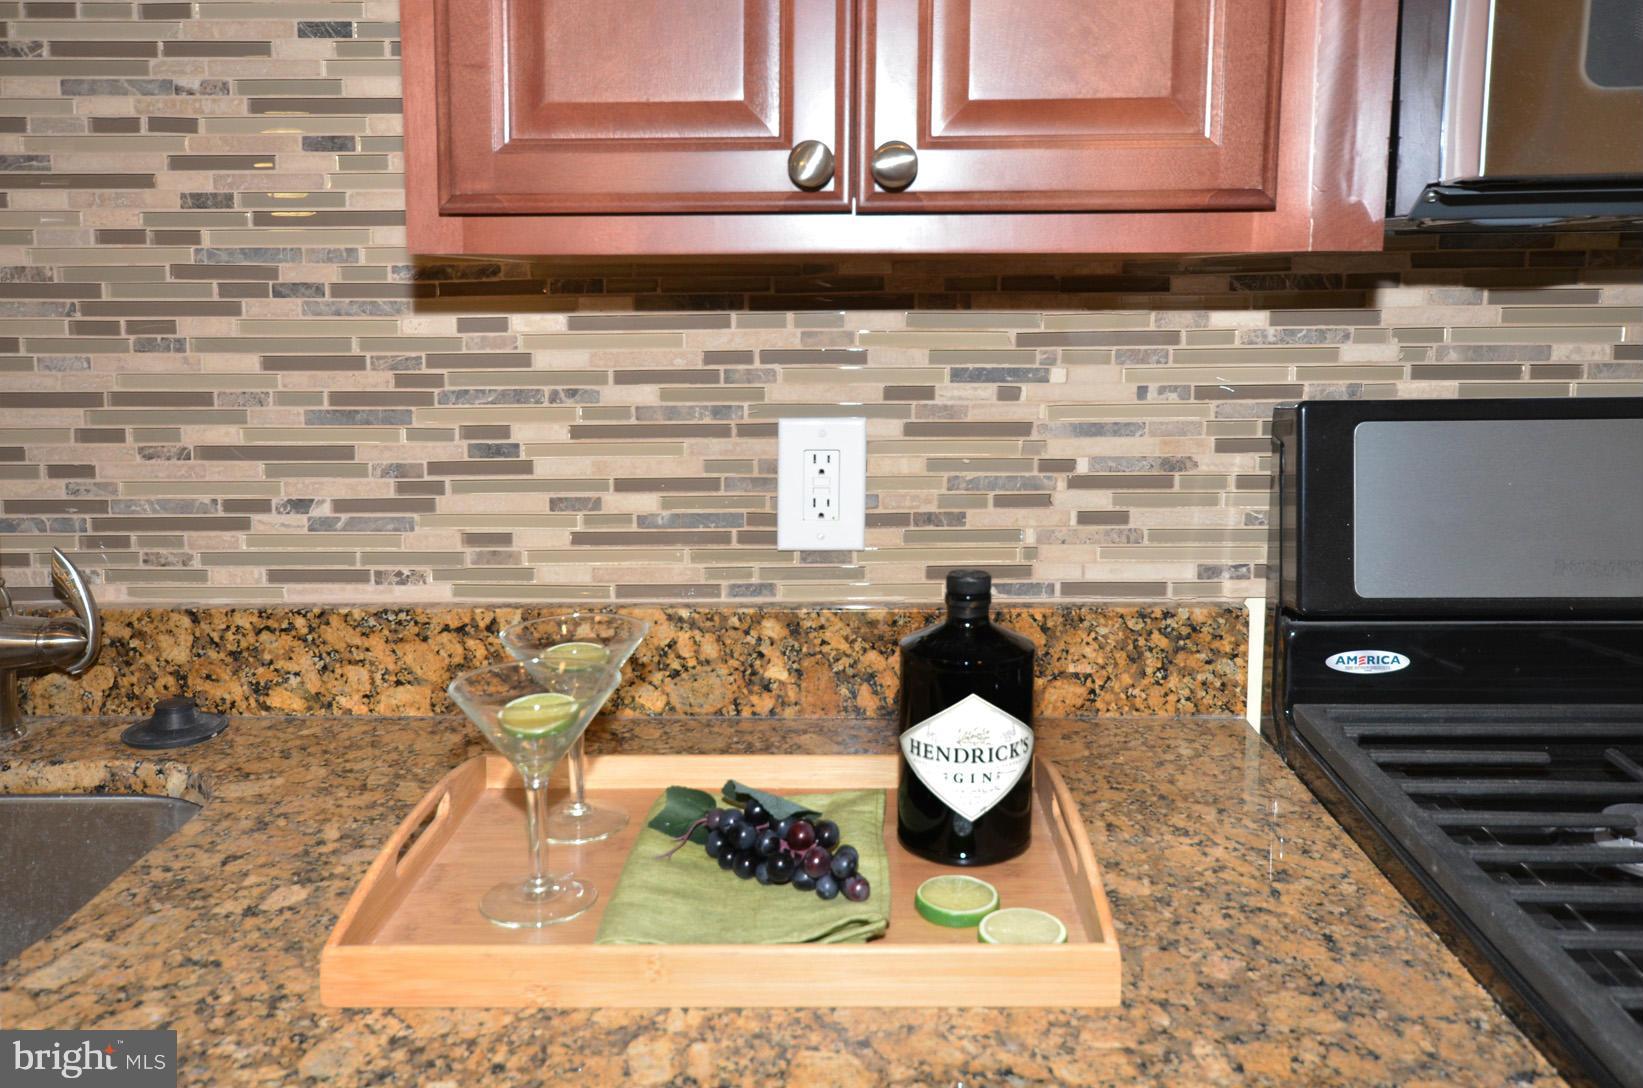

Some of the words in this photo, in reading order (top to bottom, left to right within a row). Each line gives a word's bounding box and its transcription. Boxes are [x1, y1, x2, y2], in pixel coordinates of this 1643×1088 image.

[1335, 655, 1401, 665] AMERICA
[910, 737, 1029, 763] HENDRICK'S
[953, 773, 992, 783] GIN
